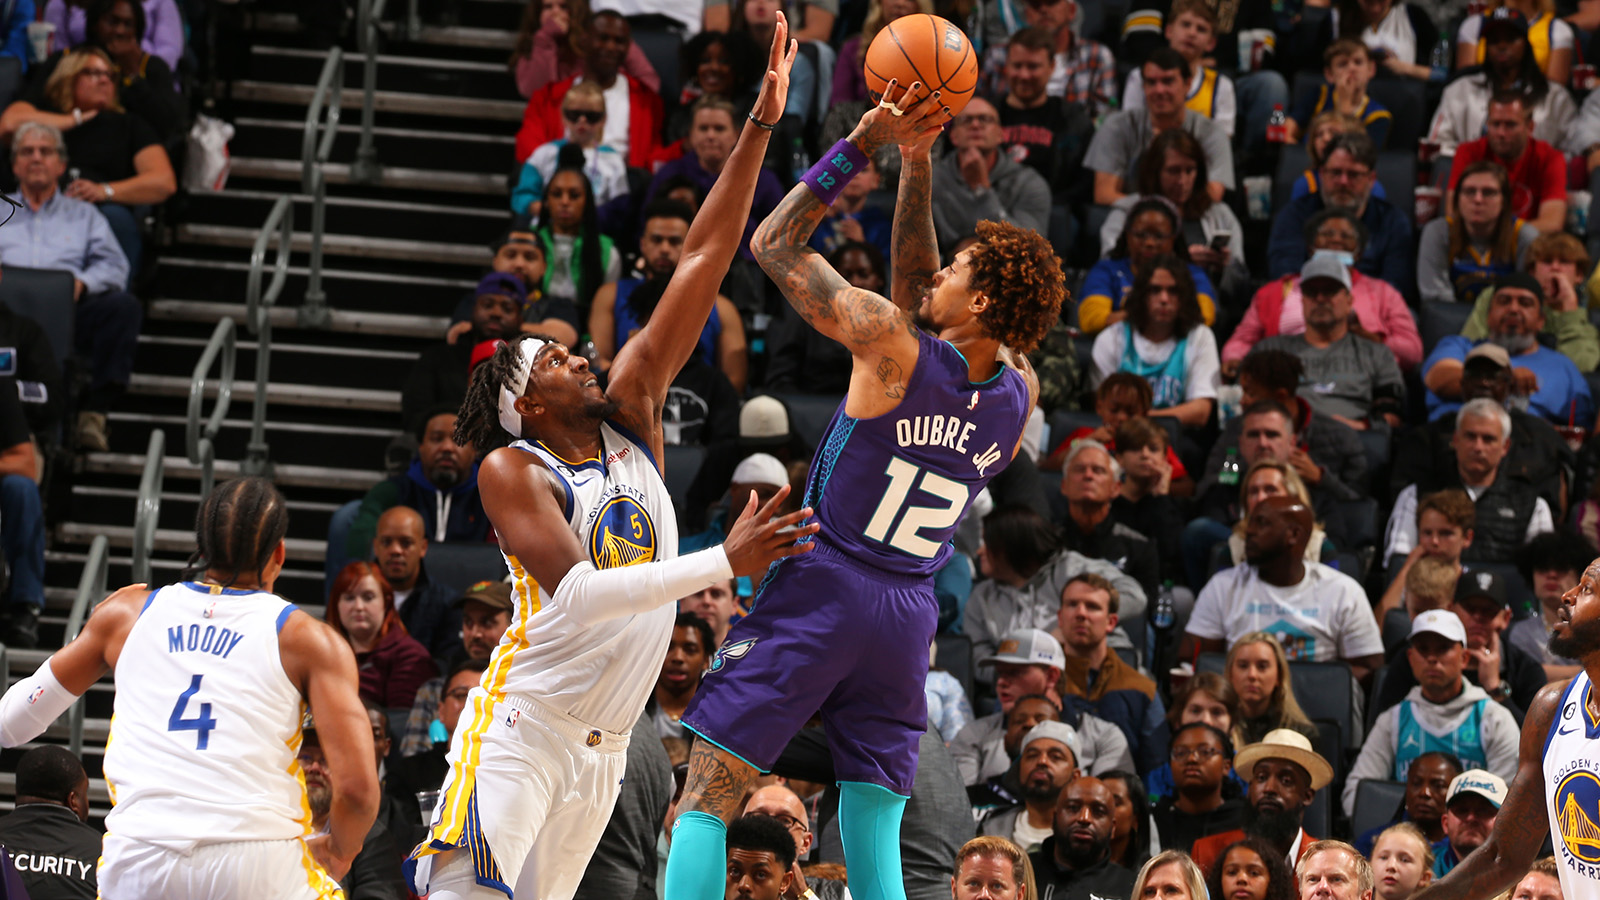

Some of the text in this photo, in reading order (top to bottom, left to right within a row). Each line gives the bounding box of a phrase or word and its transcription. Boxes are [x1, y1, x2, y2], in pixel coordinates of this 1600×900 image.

[831, 153, 853, 174] KO
[817, 171, 836, 190] 12
[896, 415, 1001, 478] OUBRE JR
[615, 484, 645, 503] STATE
[863, 456, 969, 559] 12
[630, 513, 643, 539] 5
[168, 624, 244, 659] MOODY
[168, 674, 217, 750] 4
[1553, 759, 1590, 784] GOLDEN
[8, 853, 92, 880] CURITY
